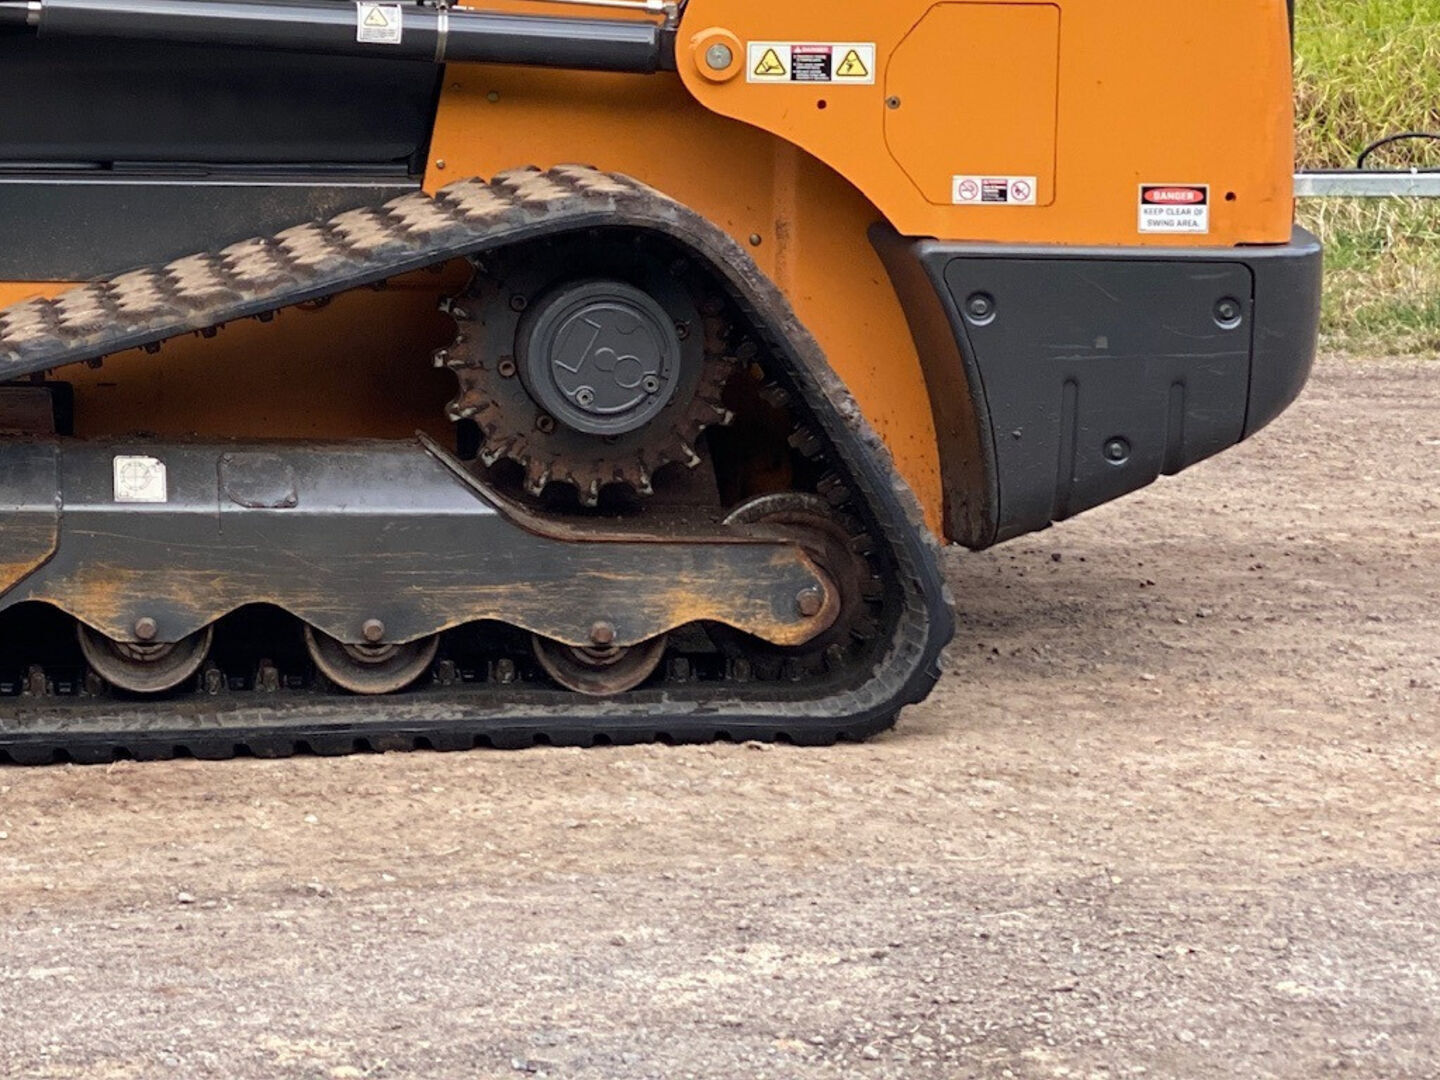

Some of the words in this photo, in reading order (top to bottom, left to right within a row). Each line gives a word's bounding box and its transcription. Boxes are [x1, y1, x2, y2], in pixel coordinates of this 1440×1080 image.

[1152, 191, 1194, 201] DANGER
[1143, 207, 1164, 216] KEEP
[1165, 207, 1192, 216] CLEAR
[1193, 207, 1204, 216] OF
[1146, 219, 1176, 228] SWING
